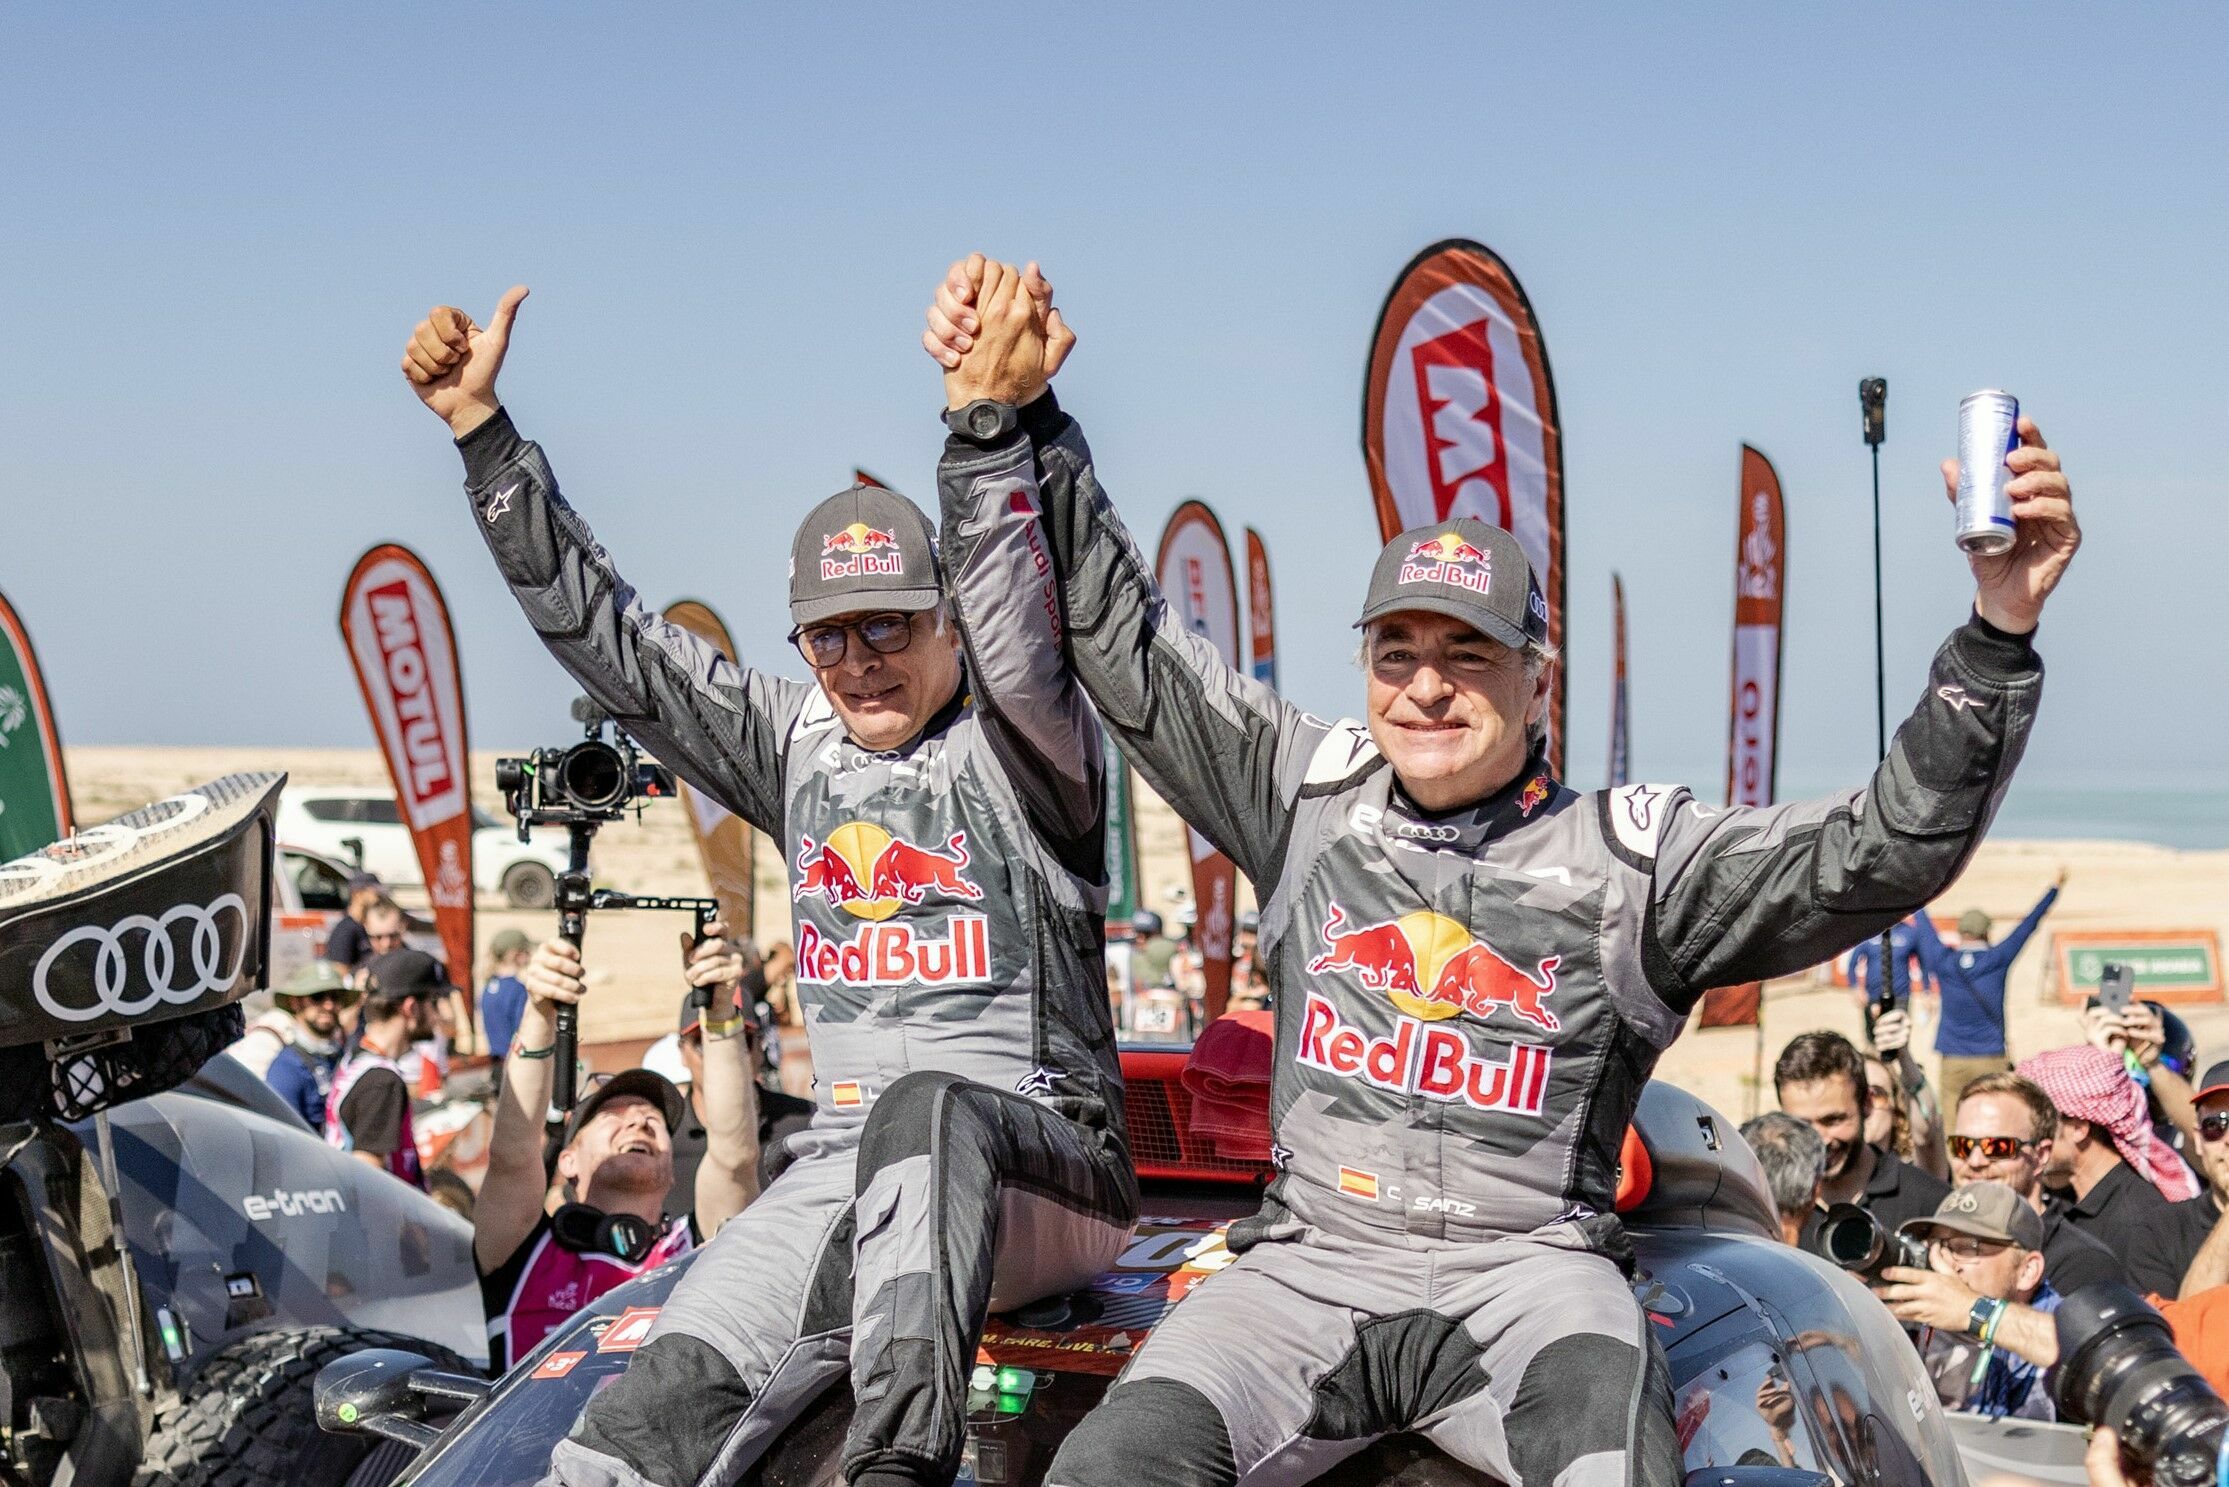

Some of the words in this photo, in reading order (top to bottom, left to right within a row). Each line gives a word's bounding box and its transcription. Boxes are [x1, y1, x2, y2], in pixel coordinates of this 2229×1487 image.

[821, 555, 860, 580] Red
[863, 554, 902, 574] Bull
[1024, 519, 1051, 577] Audi
[1401, 563, 1443, 583] Red
[1446, 565, 1490, 593] Bull
[371, 593, 447, 796] MOTUL
[799, 922, 874, 983] Red
[875, 918, 988, 983] Bull
[1299, 995, 1415, 1088] Red
[1419, 1029, 1548, 1112] Bull
[243, 1187, 346, 1220] e-tron
[1386, 1185, 1402, 1200] C
